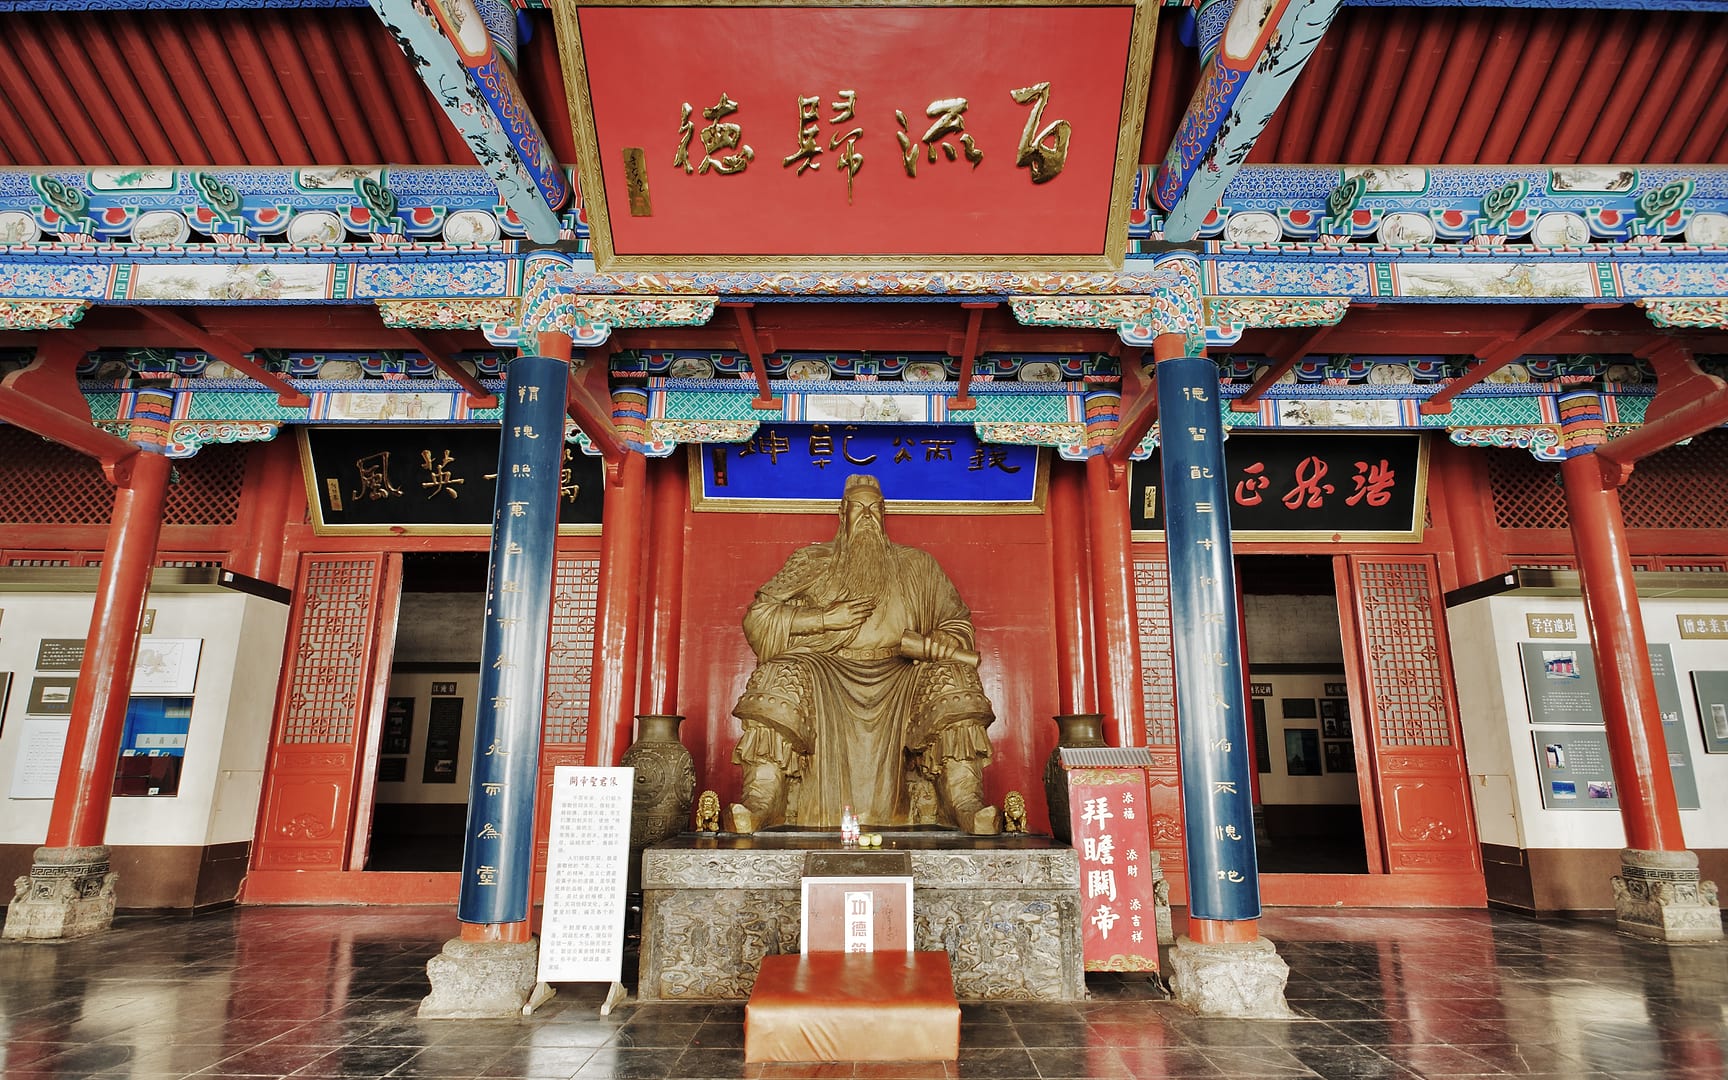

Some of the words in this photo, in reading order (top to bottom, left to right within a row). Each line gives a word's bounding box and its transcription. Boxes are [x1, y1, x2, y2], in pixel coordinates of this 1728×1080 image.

[1121, 791, 1136, 820] 添福
[1080, 796, 1121, 940] 拜瞻關帝
[1128, 898, 1144, 944] 添吉祥
